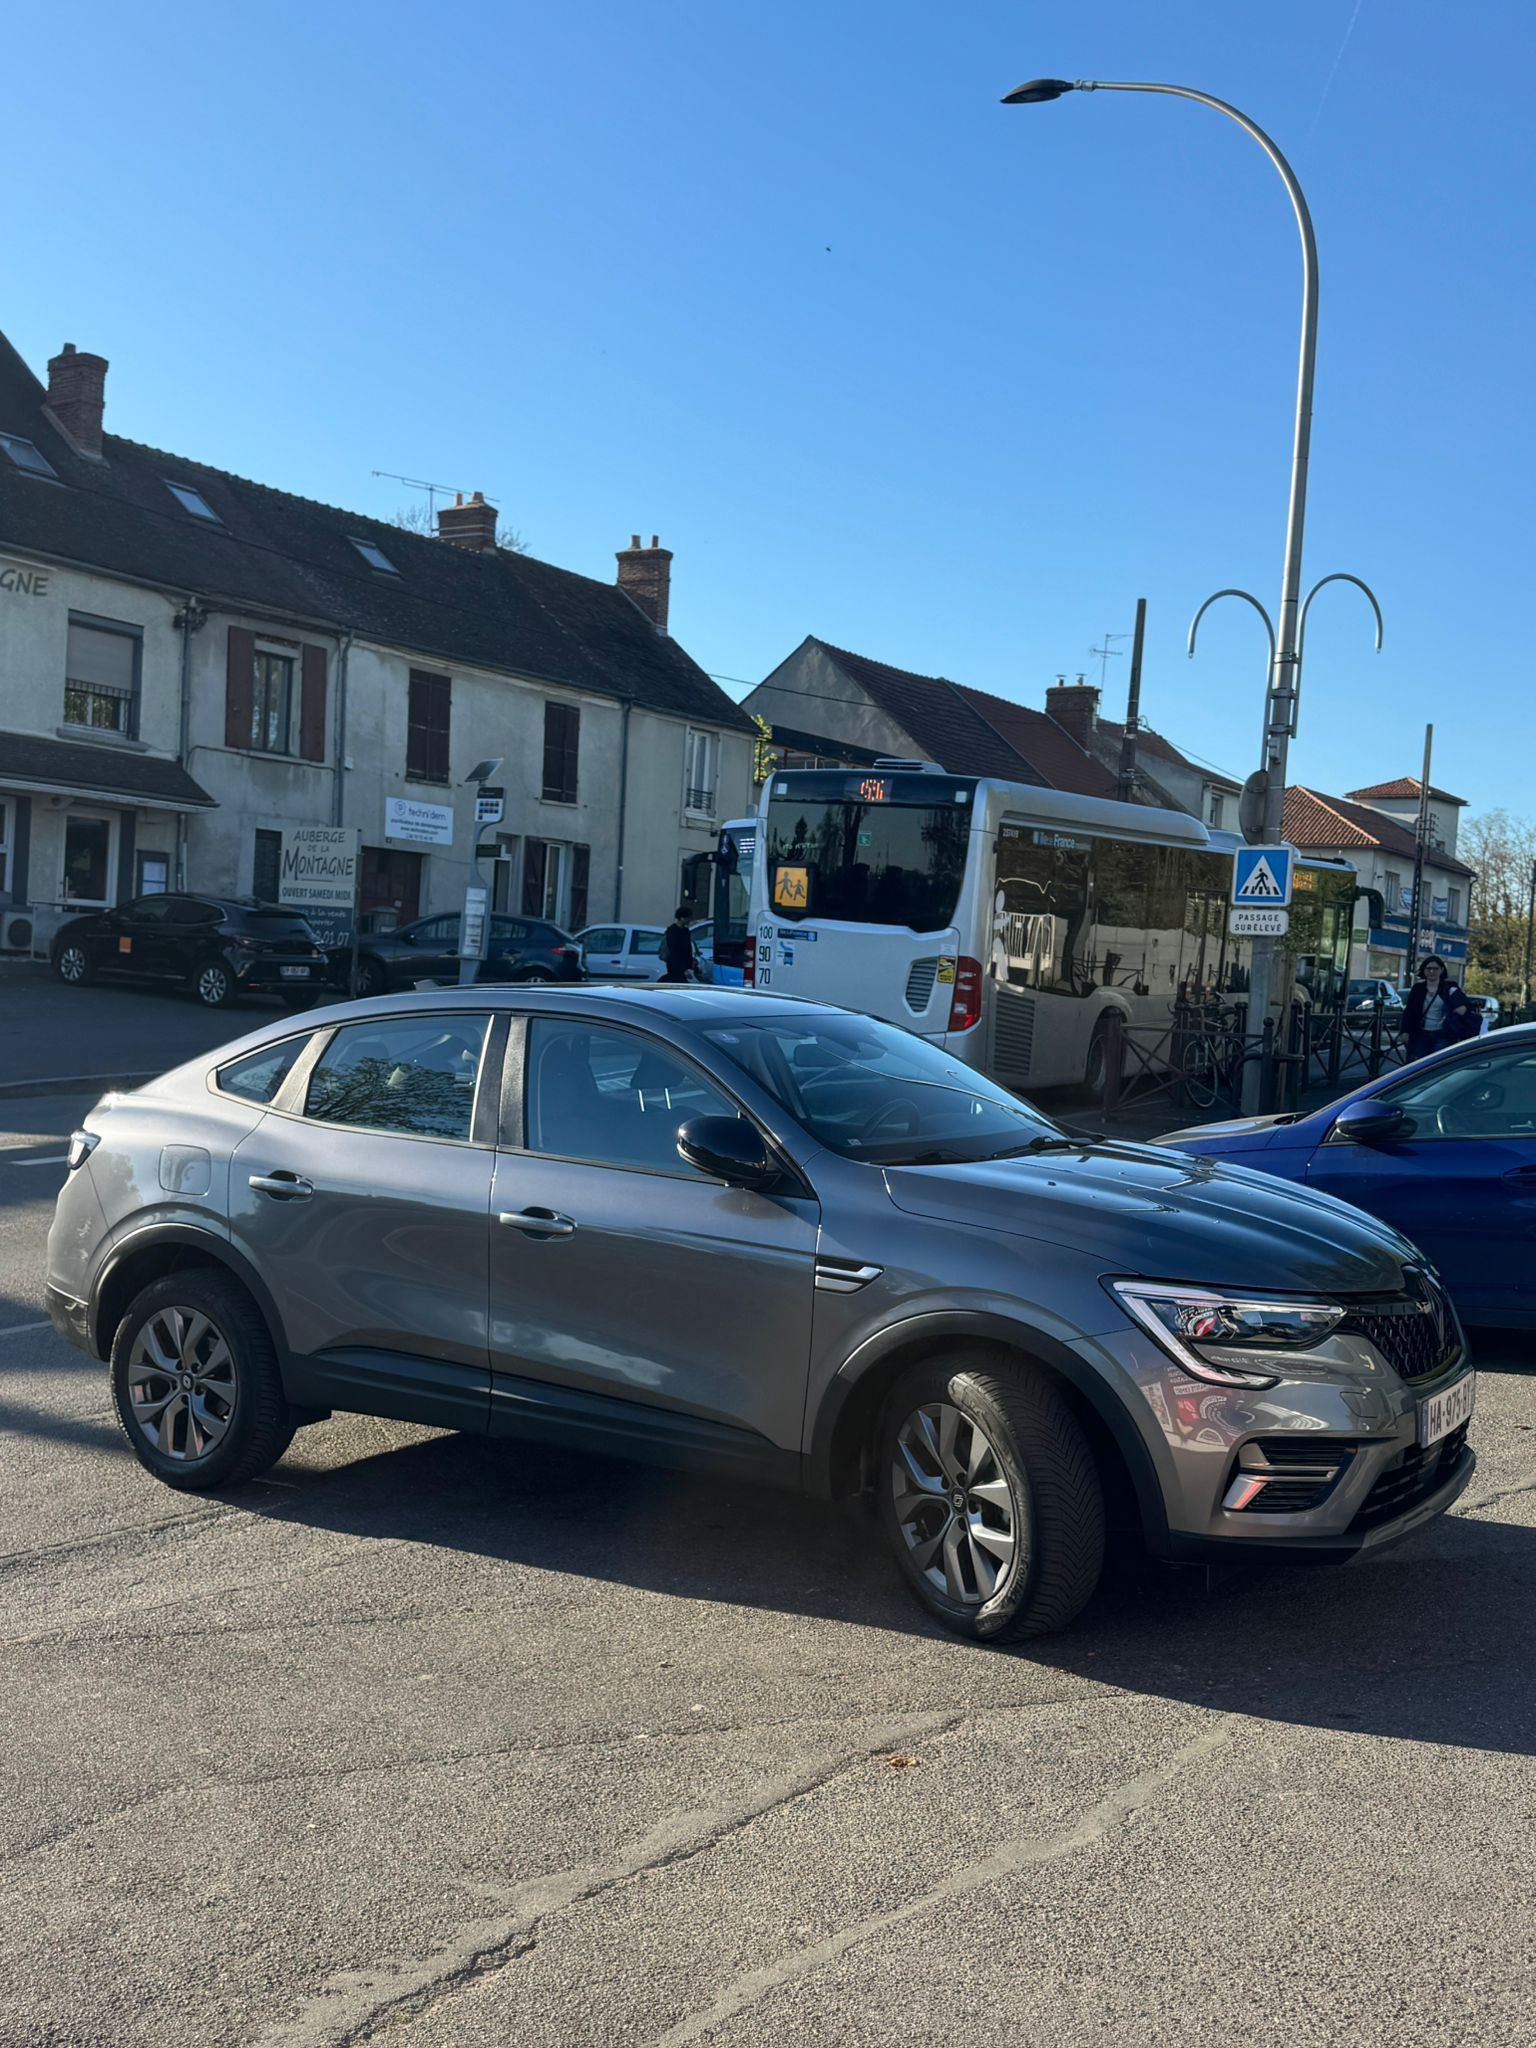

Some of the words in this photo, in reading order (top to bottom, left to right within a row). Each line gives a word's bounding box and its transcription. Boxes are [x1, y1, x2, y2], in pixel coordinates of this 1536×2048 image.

[293, 830, 346, 843] AUBERGE
[307, 844, 317, 852] DE
[320, 845, 330, 853] LA
[282, 846, 355, 880] MONTAGNE
[281, 887, 308, 898] OUVERT
[308, 888, 334, 899] SAMEDI
[1238, 914, 1279, 922] PASSAGE
[759, 926, 773, 940] 100
[1234, 923, 1281, 932] SURÉLEVÉ
[336, 931, 350, 946] 07
[758, 945, 771, 962] 90
[758, 967, 771, 985] 70
